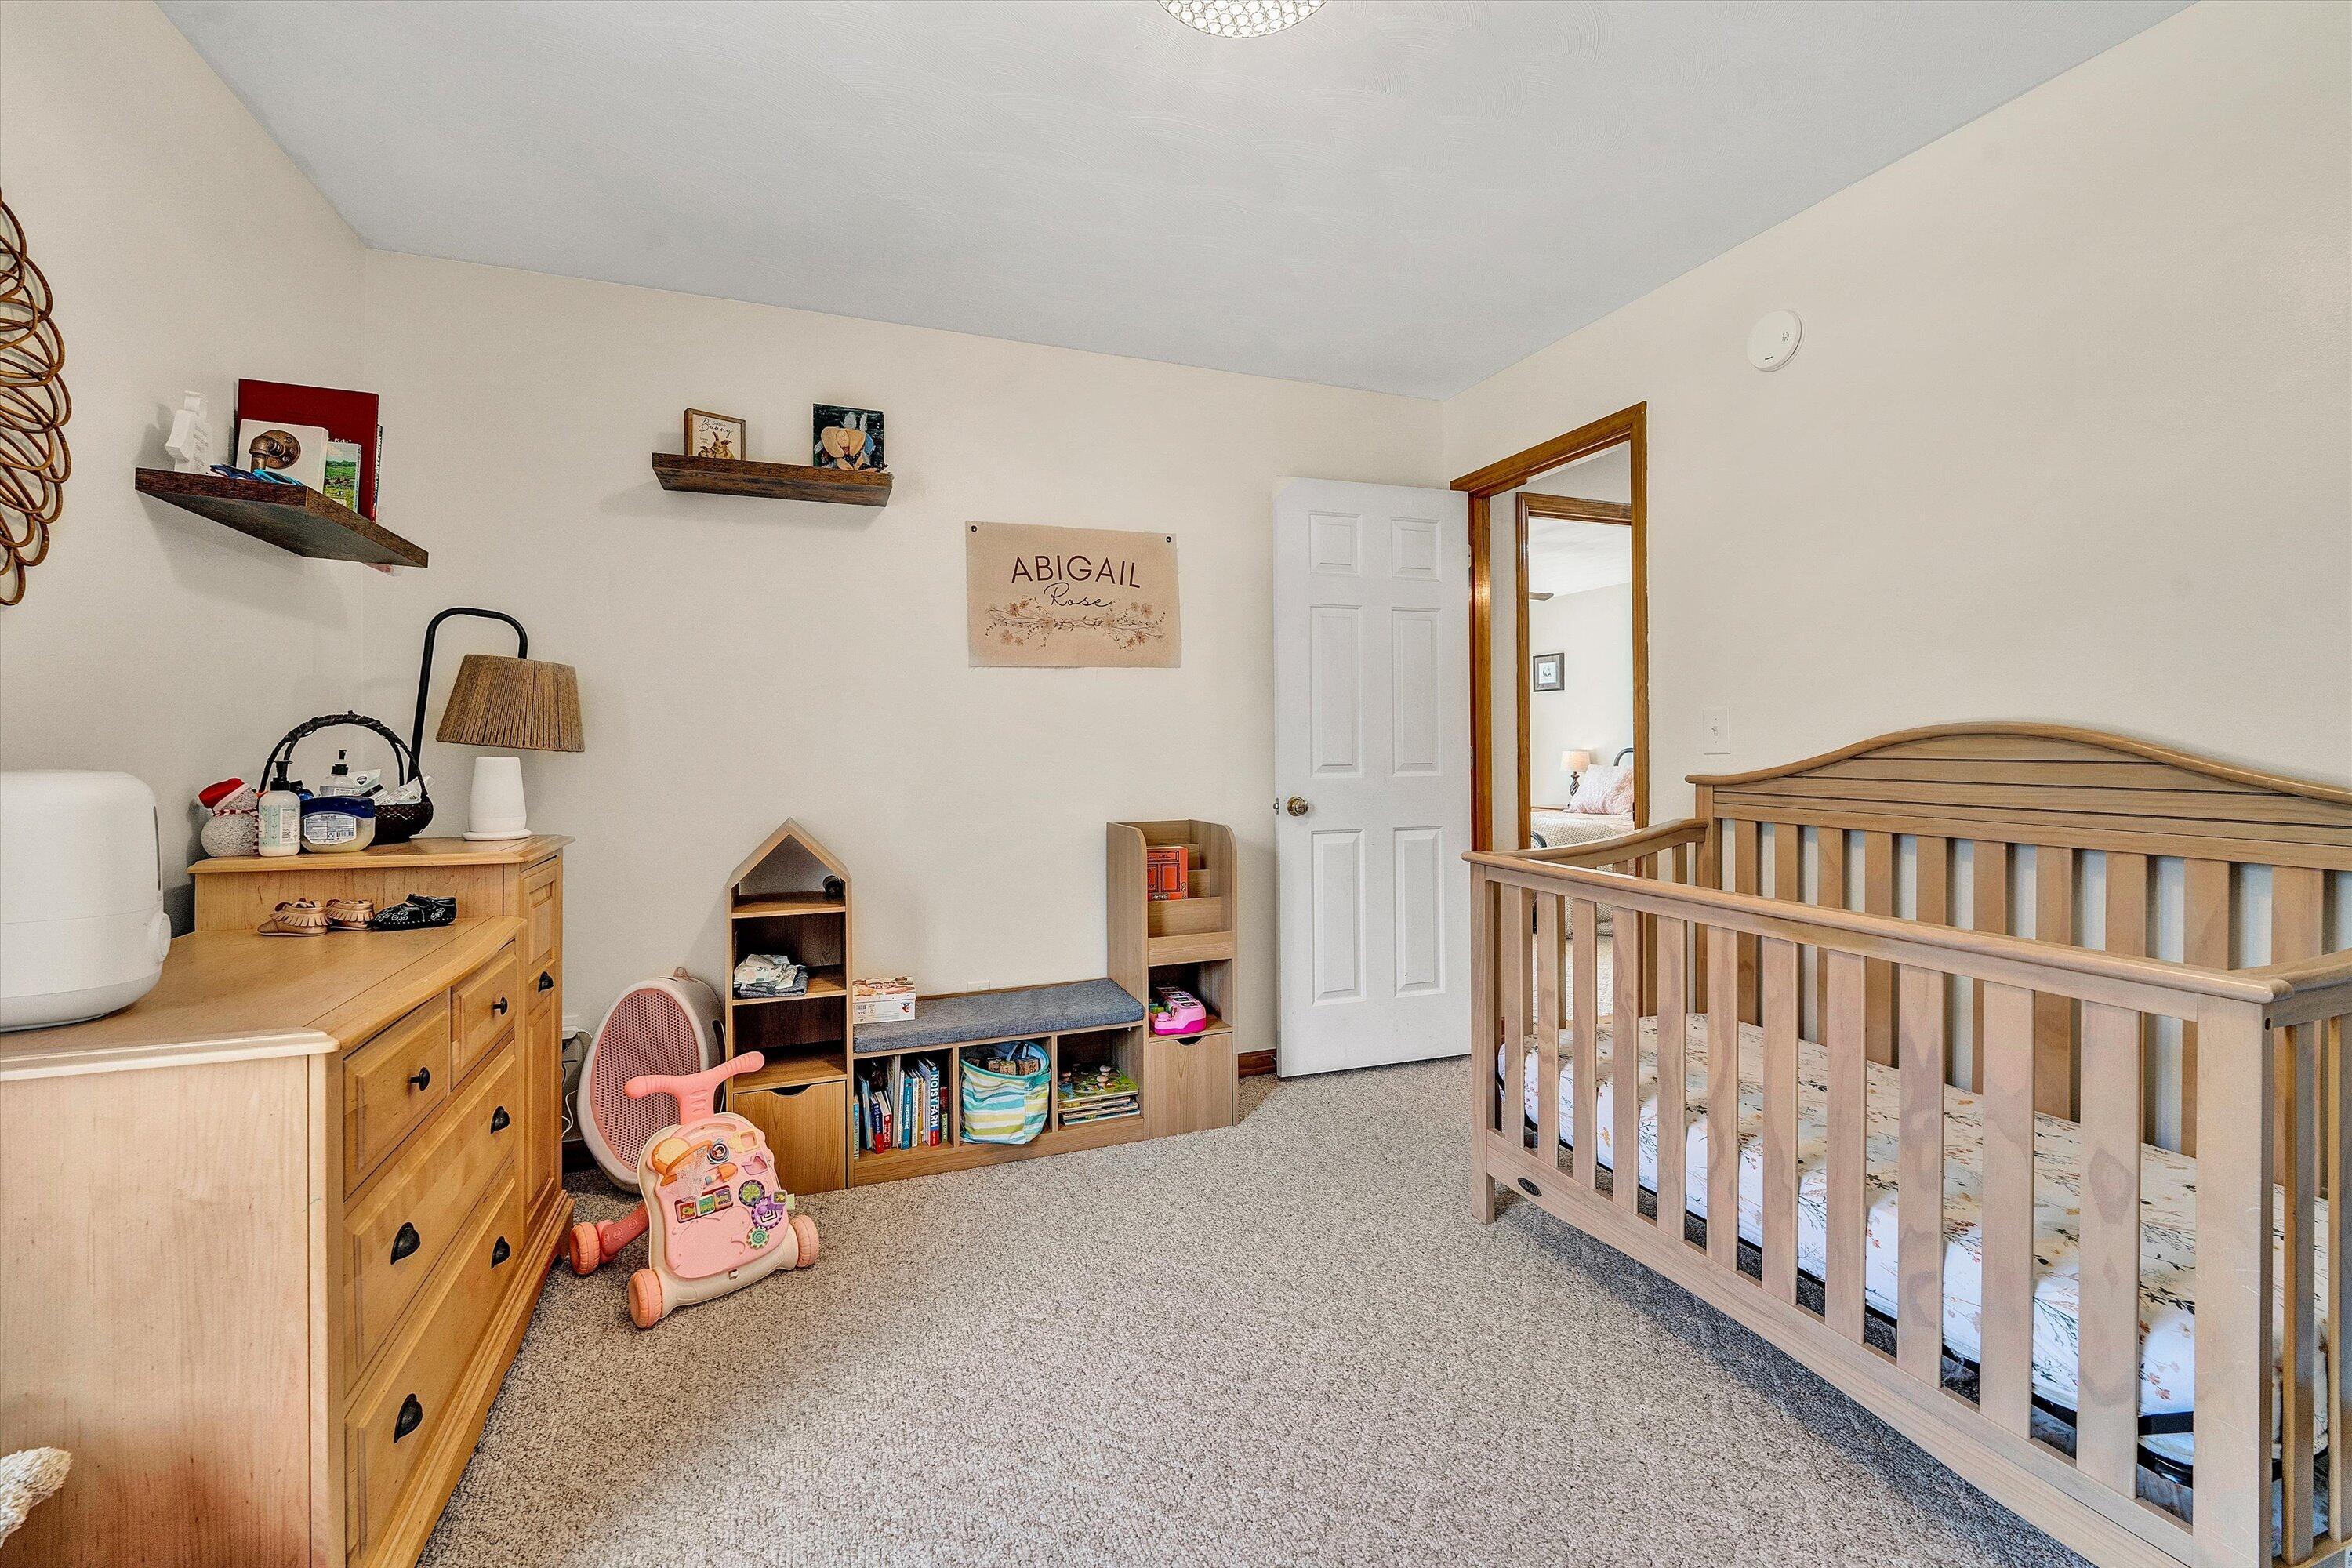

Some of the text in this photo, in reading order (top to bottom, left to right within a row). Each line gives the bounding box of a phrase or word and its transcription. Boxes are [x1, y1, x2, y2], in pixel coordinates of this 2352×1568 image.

[699, 418, 734, 438] Bunny
[1011, 555, 1140, 588] ABIGAIL
[1044, 582, 1112, 607] Rose
[930, 1074, 938, 1102] NOISY
[930, 1105, 938, 1127] FARM
